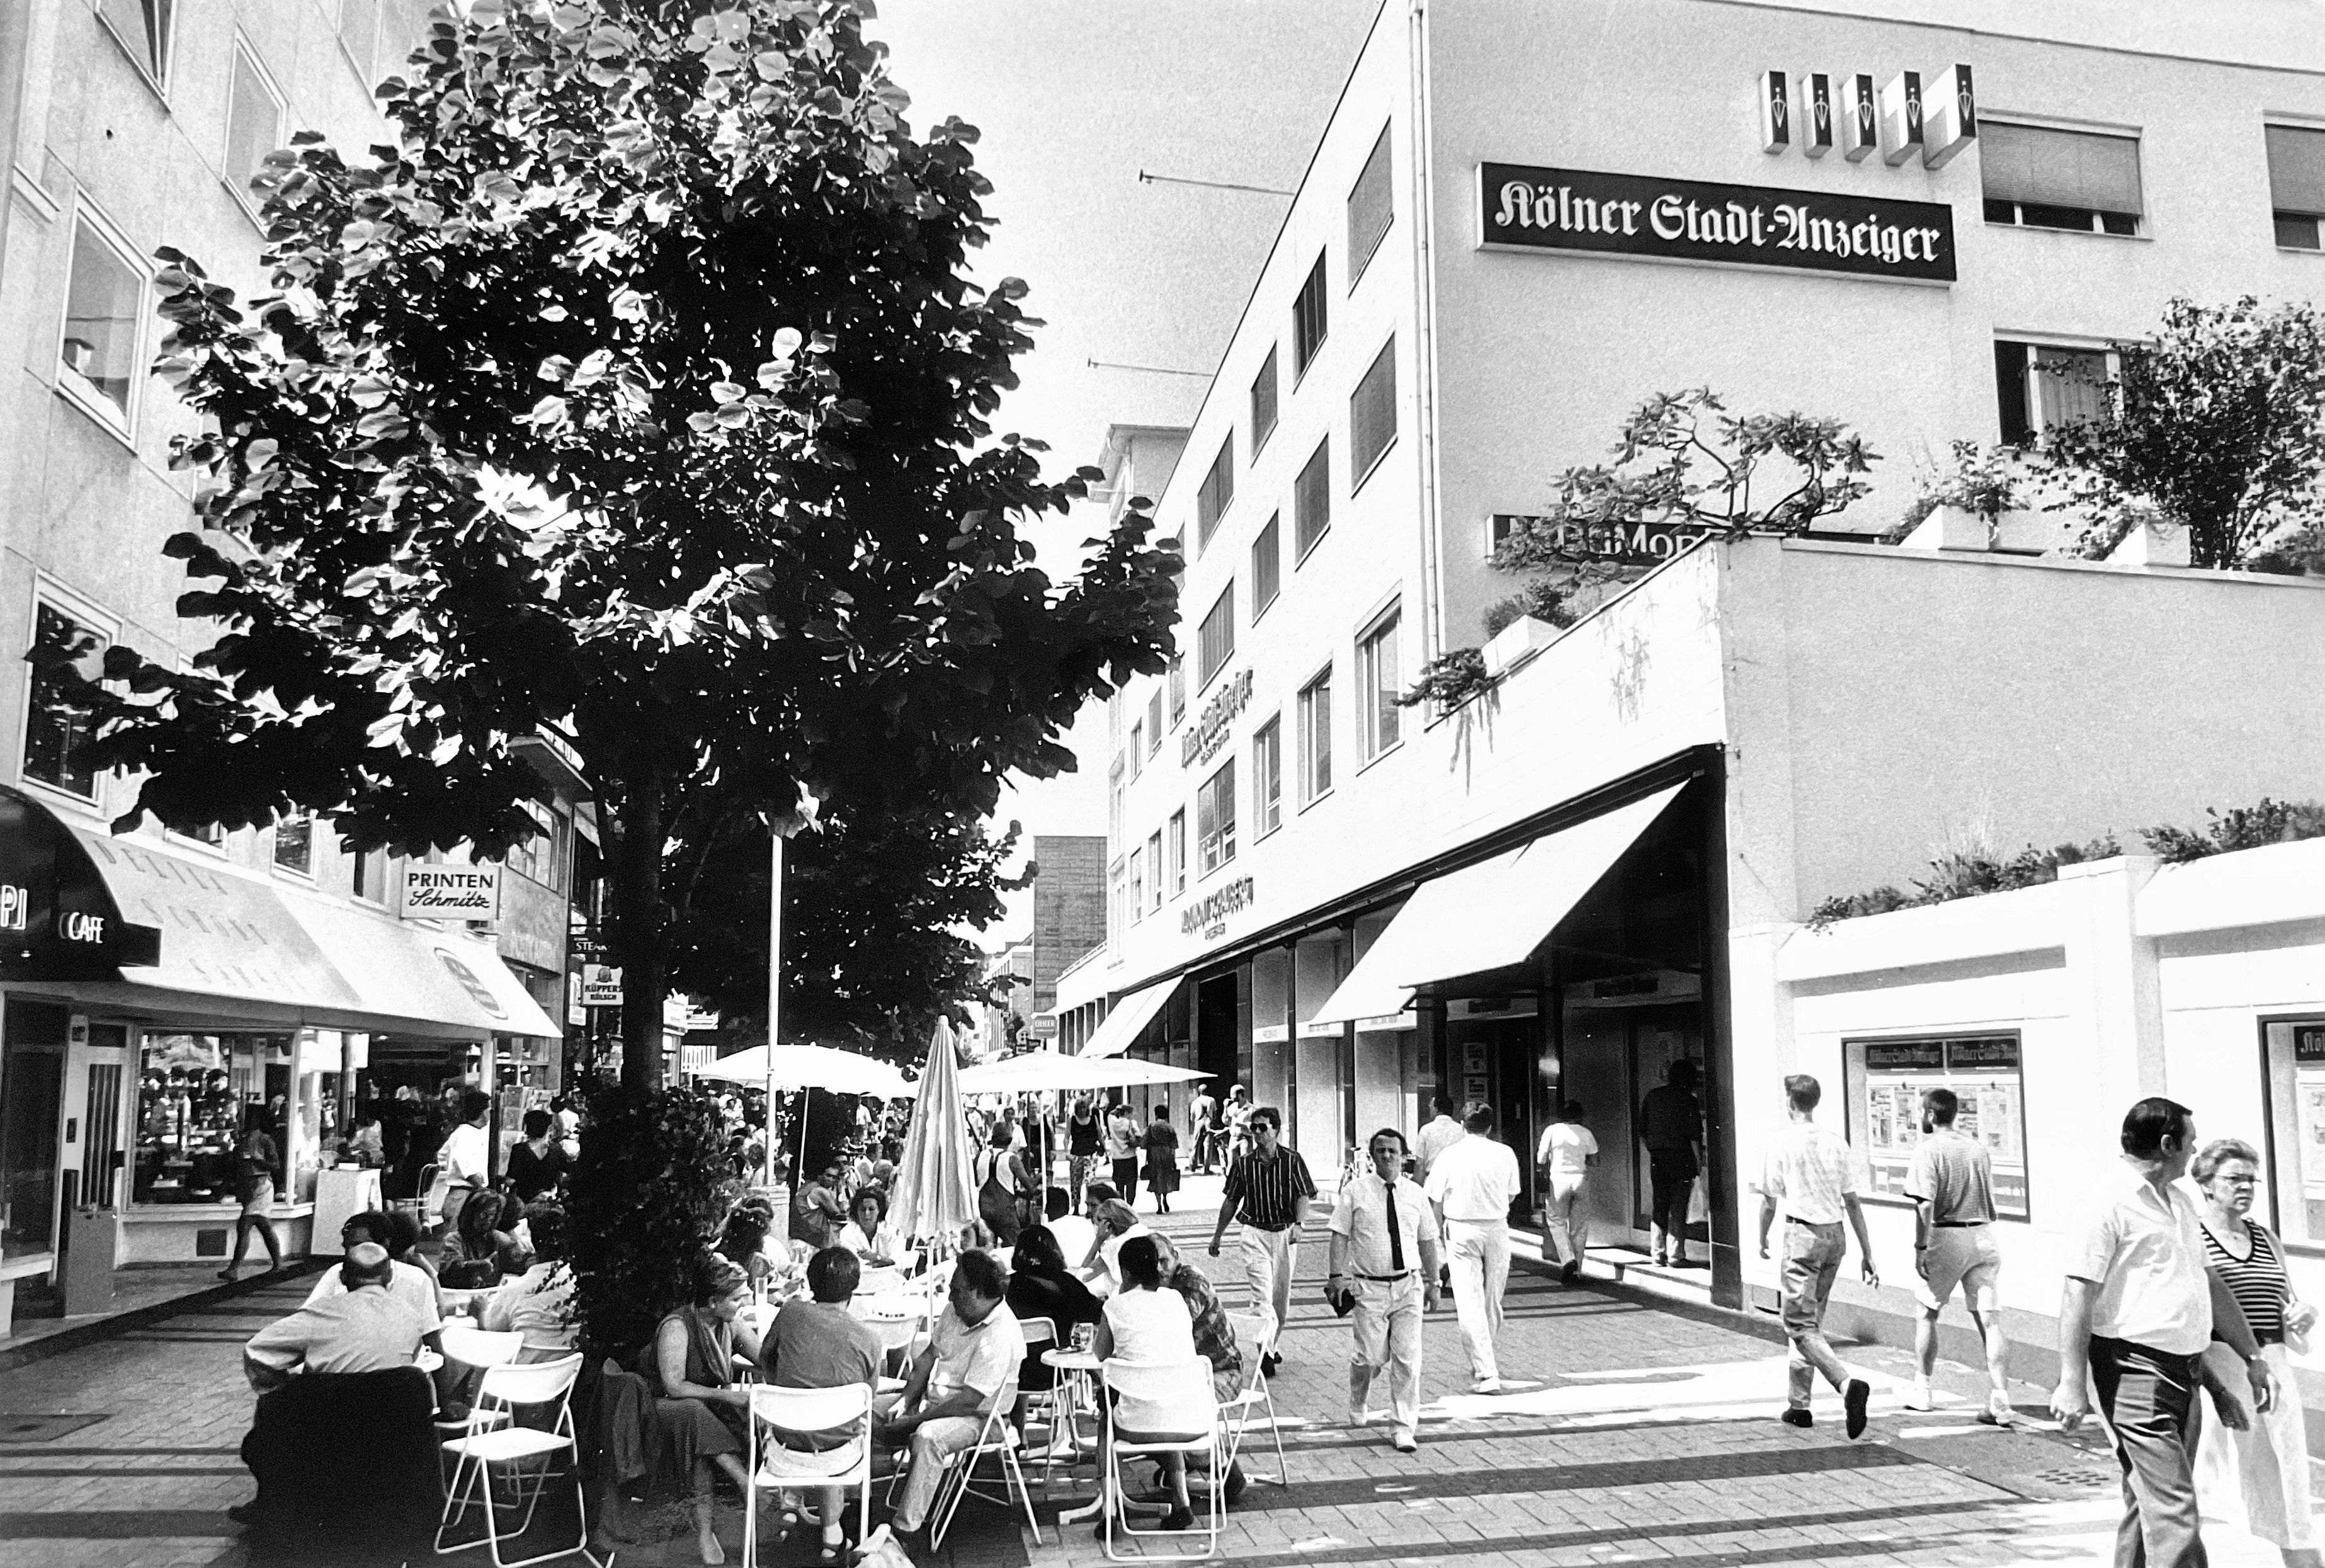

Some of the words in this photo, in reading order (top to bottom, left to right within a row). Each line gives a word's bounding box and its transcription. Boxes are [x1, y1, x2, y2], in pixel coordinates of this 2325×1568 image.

[1495, 181, 1643, 236] Kölner
[1650, 195, 1941, 264] Stadt-Anzeiger
[409, 873, 493, 888] PRINTEN
[409, 888, 490, 908] Schmitz
